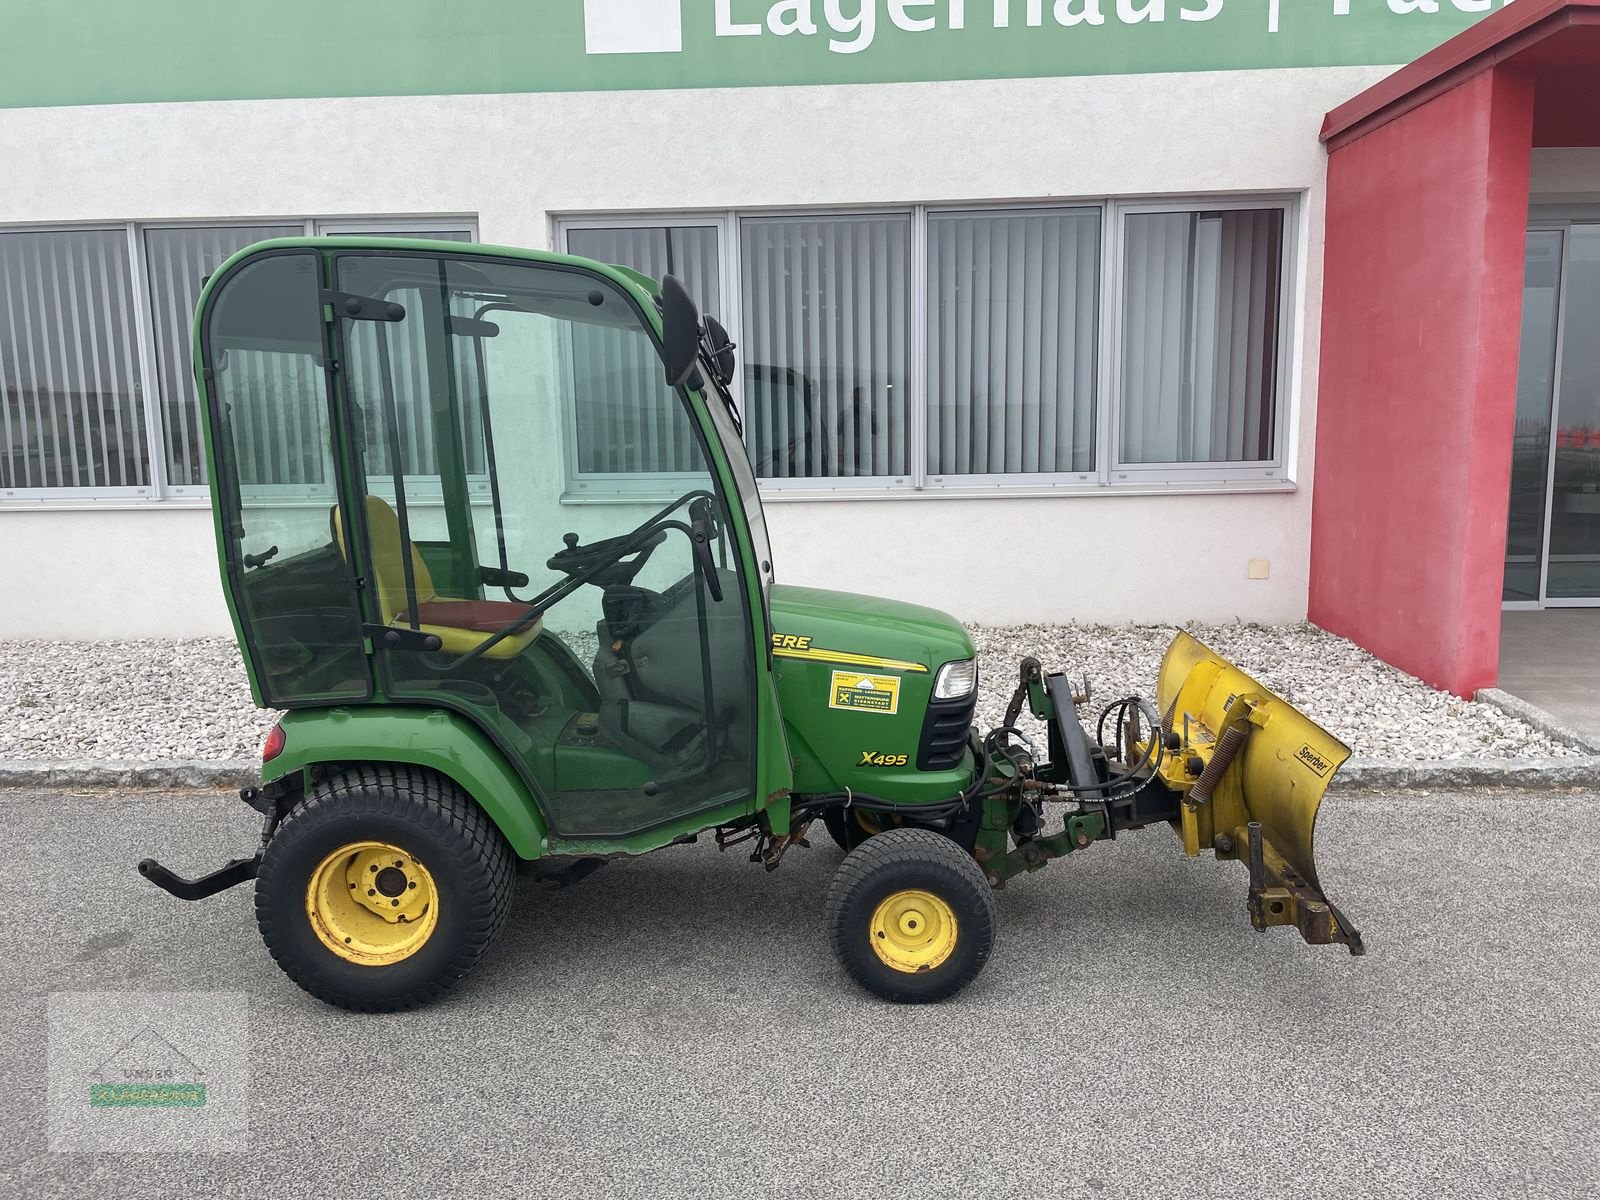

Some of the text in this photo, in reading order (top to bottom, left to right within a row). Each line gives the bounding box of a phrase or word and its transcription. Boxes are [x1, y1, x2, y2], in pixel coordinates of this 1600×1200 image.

[715, 0, 1224, 54] Lageau
[858, 751, 908, 766] X495
[1299, 746, 1328, 771] Sperber
